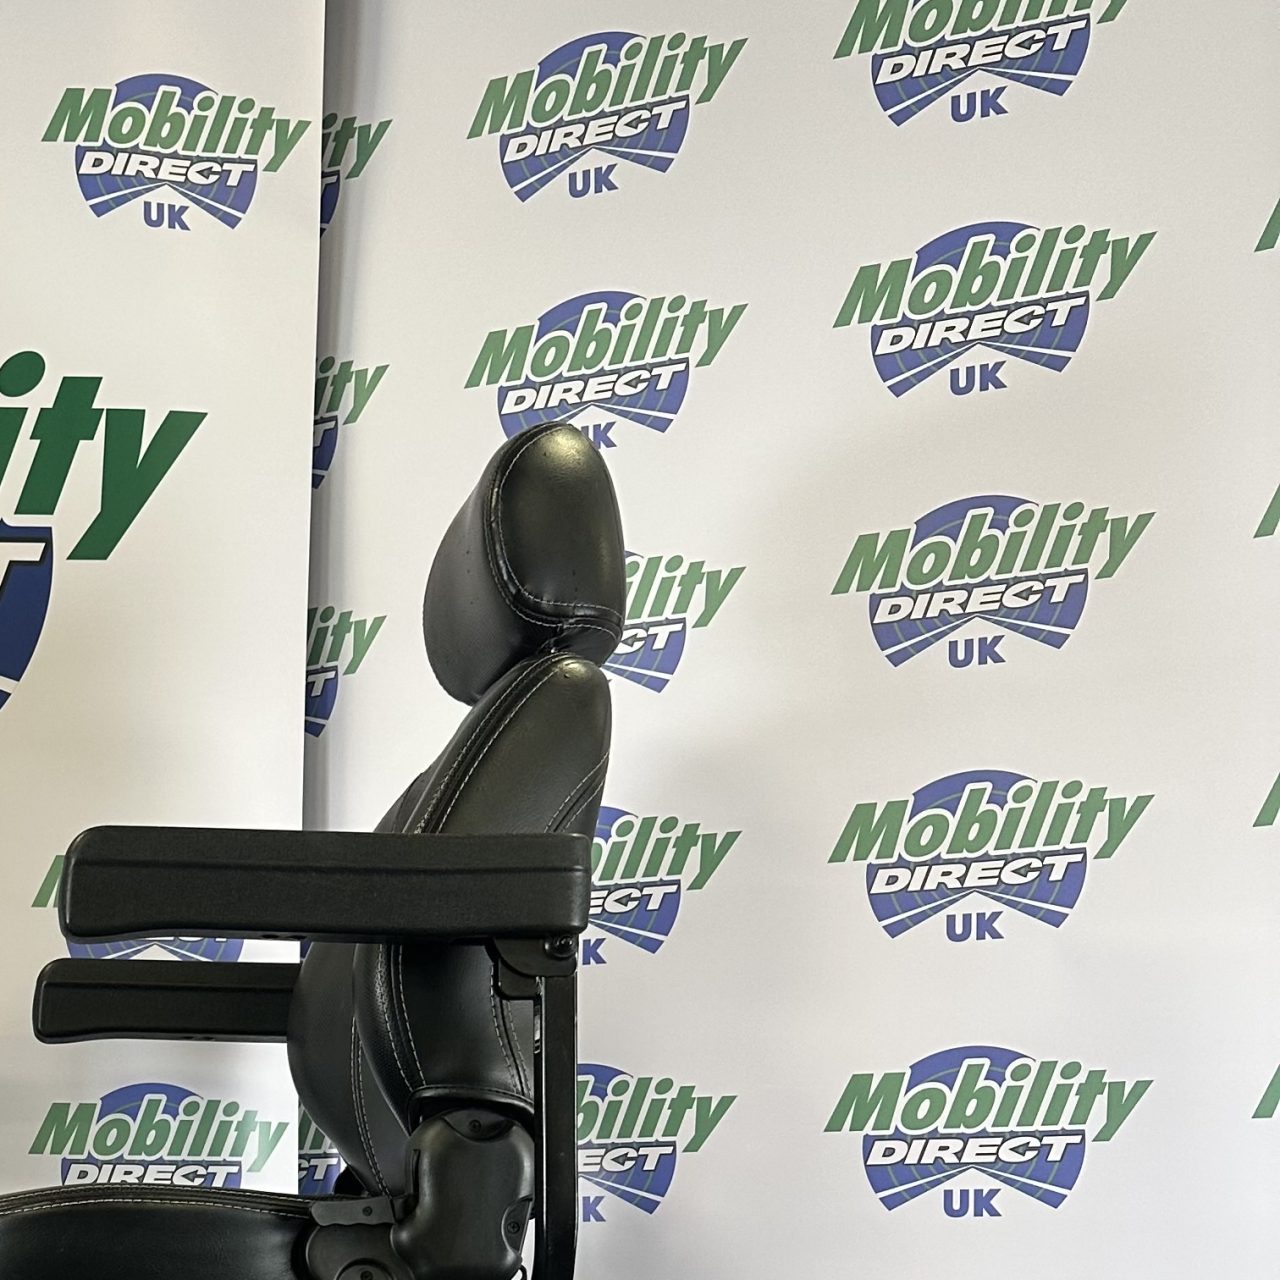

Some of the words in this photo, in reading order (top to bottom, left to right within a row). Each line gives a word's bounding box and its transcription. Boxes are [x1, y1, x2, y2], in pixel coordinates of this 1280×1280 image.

[875, 19, 1087, 85] DIRECT
[464, 31, 747, 139] Mobility
[950, 86, 1008, 123] UK
[44, 88, 313, 173] Mobility
[502, 100, 686, 163] DIRECT
[80, 148, 255, 187] DIRECT
[568, 163, 619, 198] UK
[142, 202, 190, 232] UK
[831, 223, 1155, 329] Mobility
[463, 294, 747, 389] Mobility
[874, 296, 1086, 355] DIRECT
[500, 362, 686, 415] DIRECT
[949, 361, 1007, 396] UK
[829, 500, 1154, 595] Mobility
[872, 574, 1084, 624] DIRECT
[948, 635, 1006, 668] UK
[826, 779, 1153, 864] Mobility
[870, 853, 1083, 894] DIRECT
[946, 911, 1004, 942] UK
[822, 1059, 1153, 1141] Mobility
[26, 1097, 290, 1172] Mobility
[866, 1135, 1082, 1165] DIRECT
[65, 1160, 239, 1186] DIRECT
[943, 1189, 1002, 1217] UK
